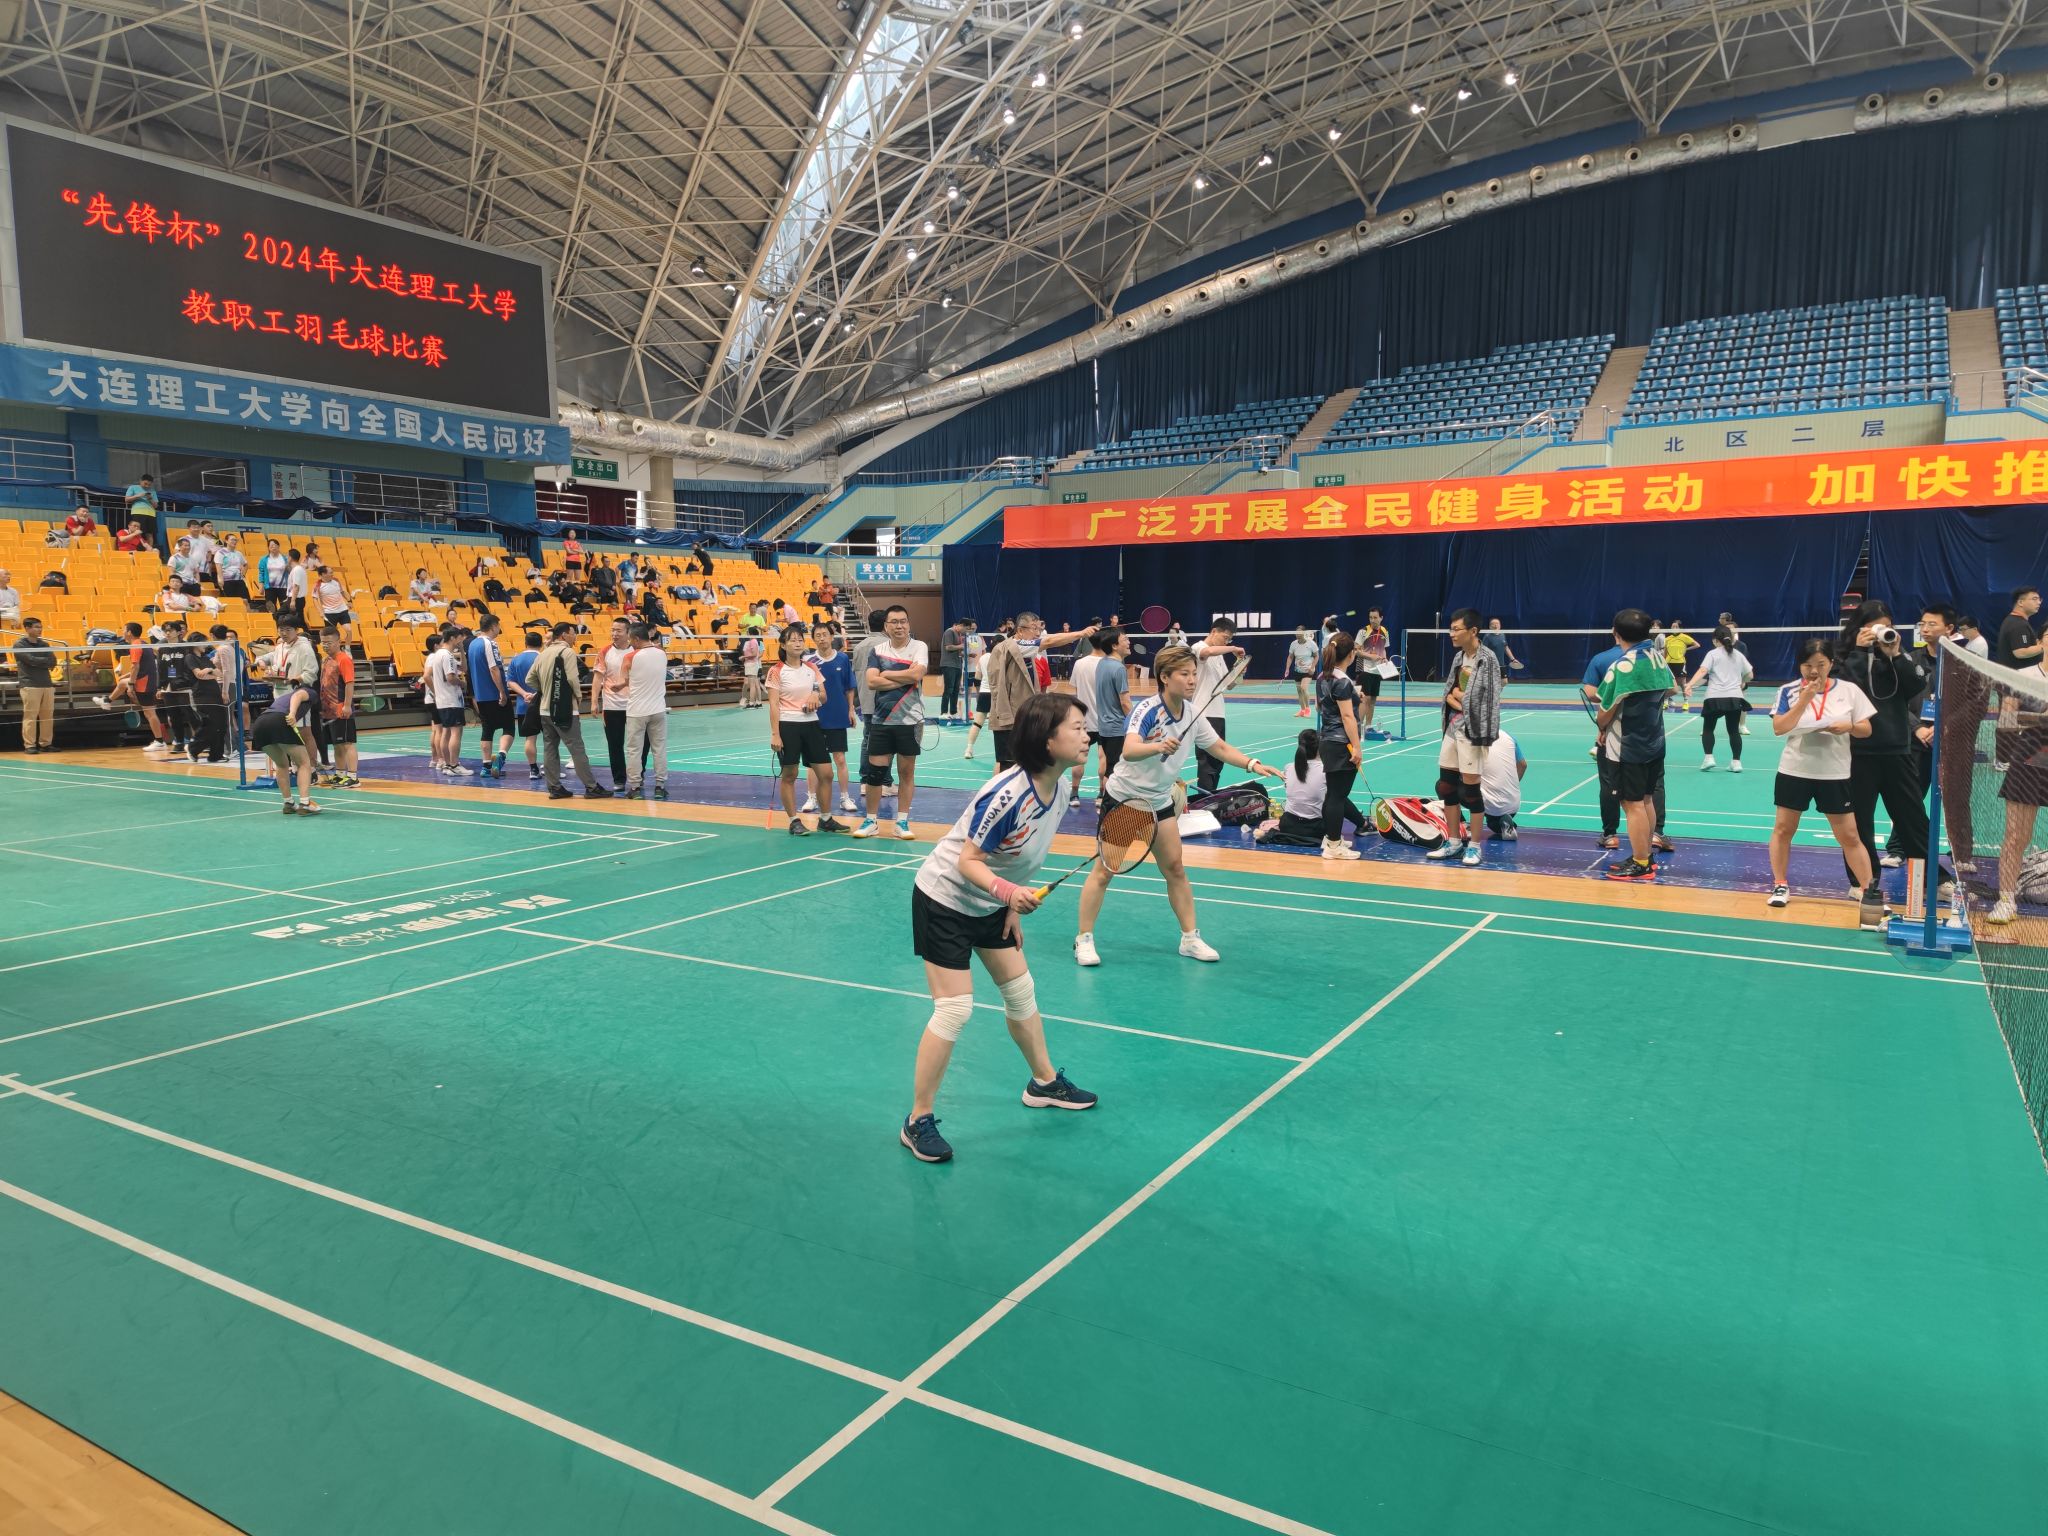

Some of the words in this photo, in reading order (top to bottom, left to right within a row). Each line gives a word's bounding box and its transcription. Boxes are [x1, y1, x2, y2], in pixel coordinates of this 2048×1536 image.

[62, 189, 220, 250] “先锋杯”
[244, 232, 518, 322] 2024年大连理工大学
[181, 289, 449, 369] 教职工羽毛球比赛
[48, 360, 547, 458] 大连理工大学向全国人民问好
[1664, 419, 1886, 453] 北区二层
[576, 460, 613, 472] 安全出口
[1086, 472, 1704, 541] 广泛开展全民健身活动
[1807, 449, 2048, 506] 加快推
[862, 563, 907, 573] 安全出口
[553, 680, 562, 700] YONEX
[1130, 708, 1146, 726] YONEX
[977, 807, 1002, 839] YONEX
